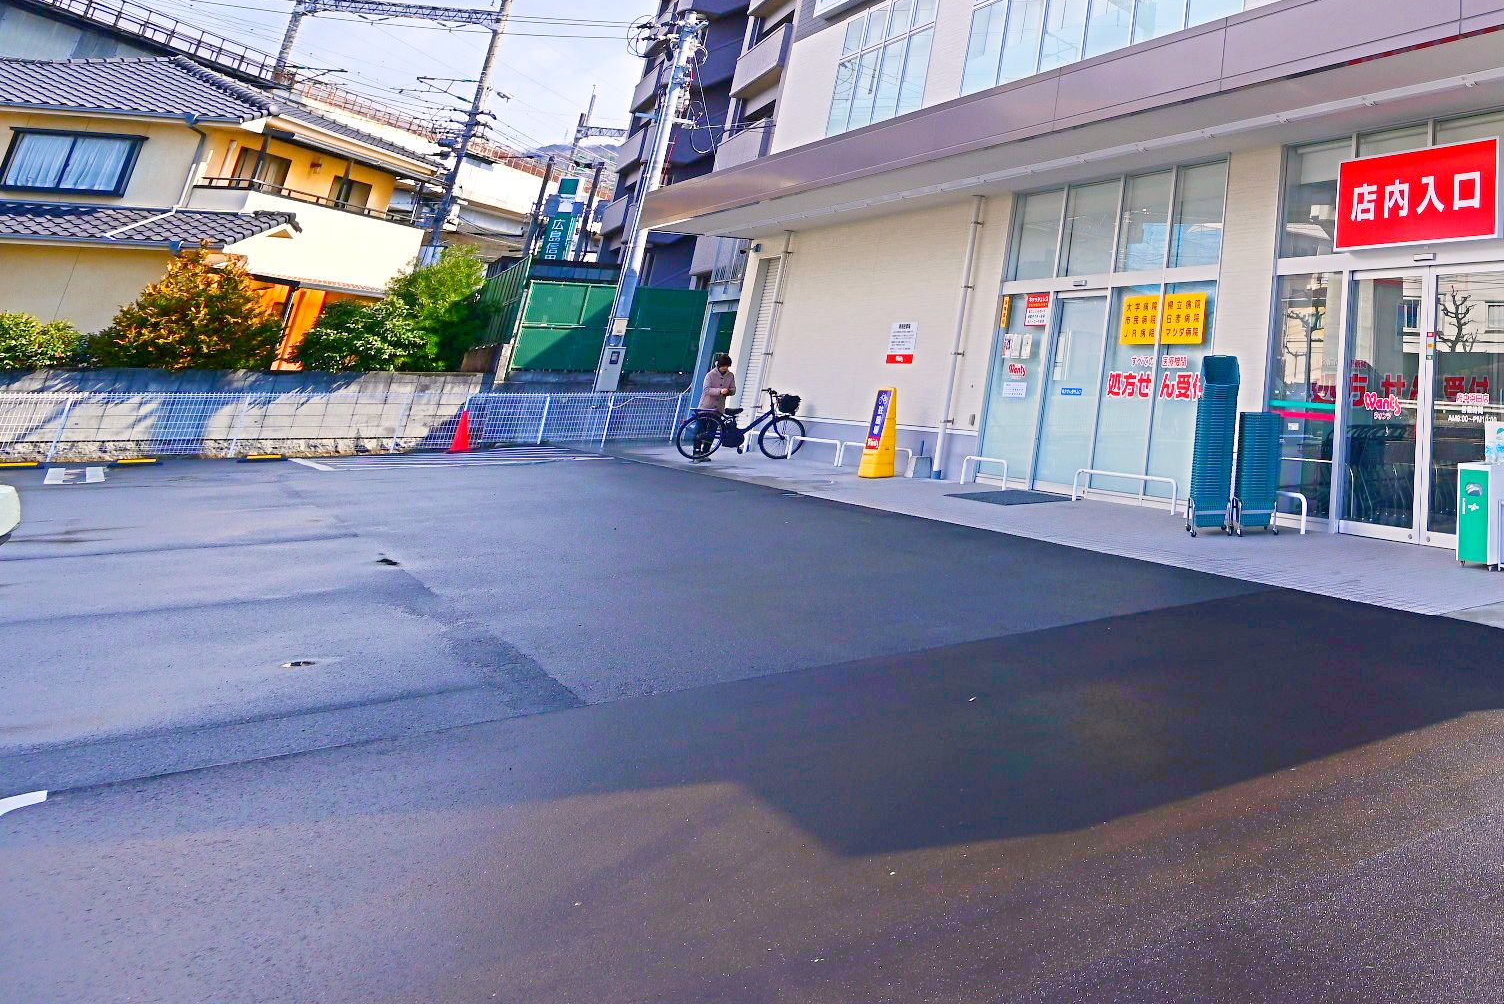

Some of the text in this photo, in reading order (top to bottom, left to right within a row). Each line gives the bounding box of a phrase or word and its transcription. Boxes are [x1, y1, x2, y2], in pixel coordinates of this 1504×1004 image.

[1350, 170, 1482, 223] 店内入口
[1364, 391, 1402, 417] Wants
